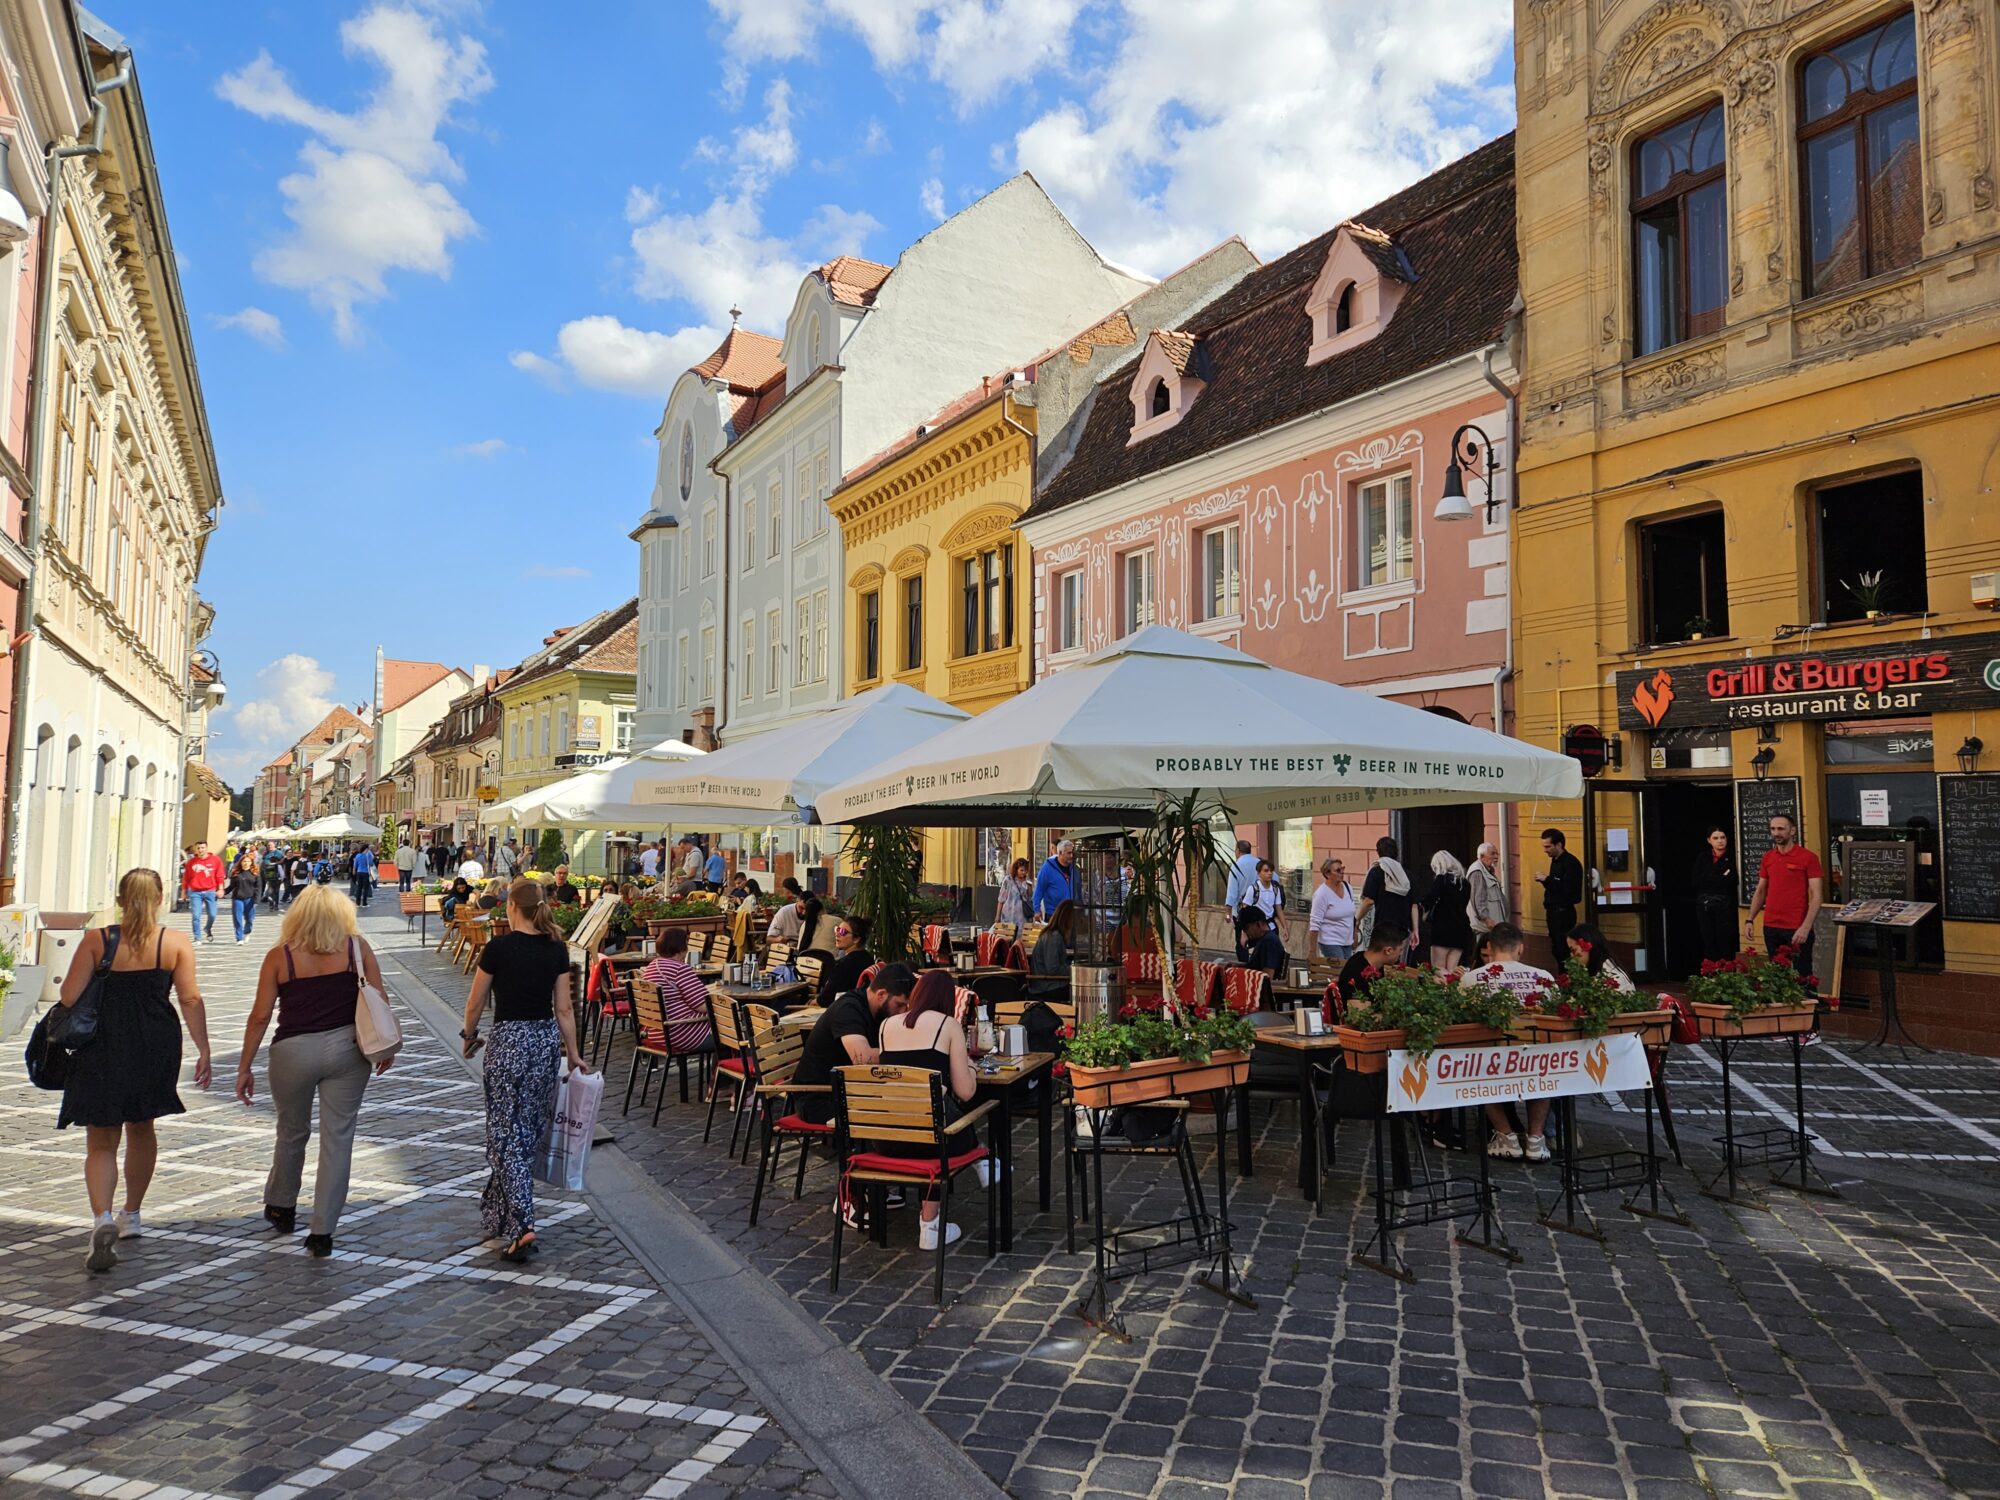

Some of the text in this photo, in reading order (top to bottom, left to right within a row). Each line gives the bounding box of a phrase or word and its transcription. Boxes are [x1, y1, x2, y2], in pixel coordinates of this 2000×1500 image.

[1707, 654, 1951, 697] Grill & Burgers
[1729, 692, 1922, 718] restaurant & bar
[1156, 758, 1504, 778] PROBABLY THE BEST BEER IN THE WORLD
[722, 785, 728, 794] IN
[730, 785, 740, 795] THE
[742, 787, 761, 797] WORLD
[844, 765, 1000, 808] PROBABLY THE BEST BEER IN THE WORLD
[1851, 849, 1905, 862] SPECIALE
[1504, 971, 1532, 980] VISIT
[1437, 1050, 1579, 1079] Grill & Burgers
[1455, 1077, 1560, 1100] restaurant & bar
